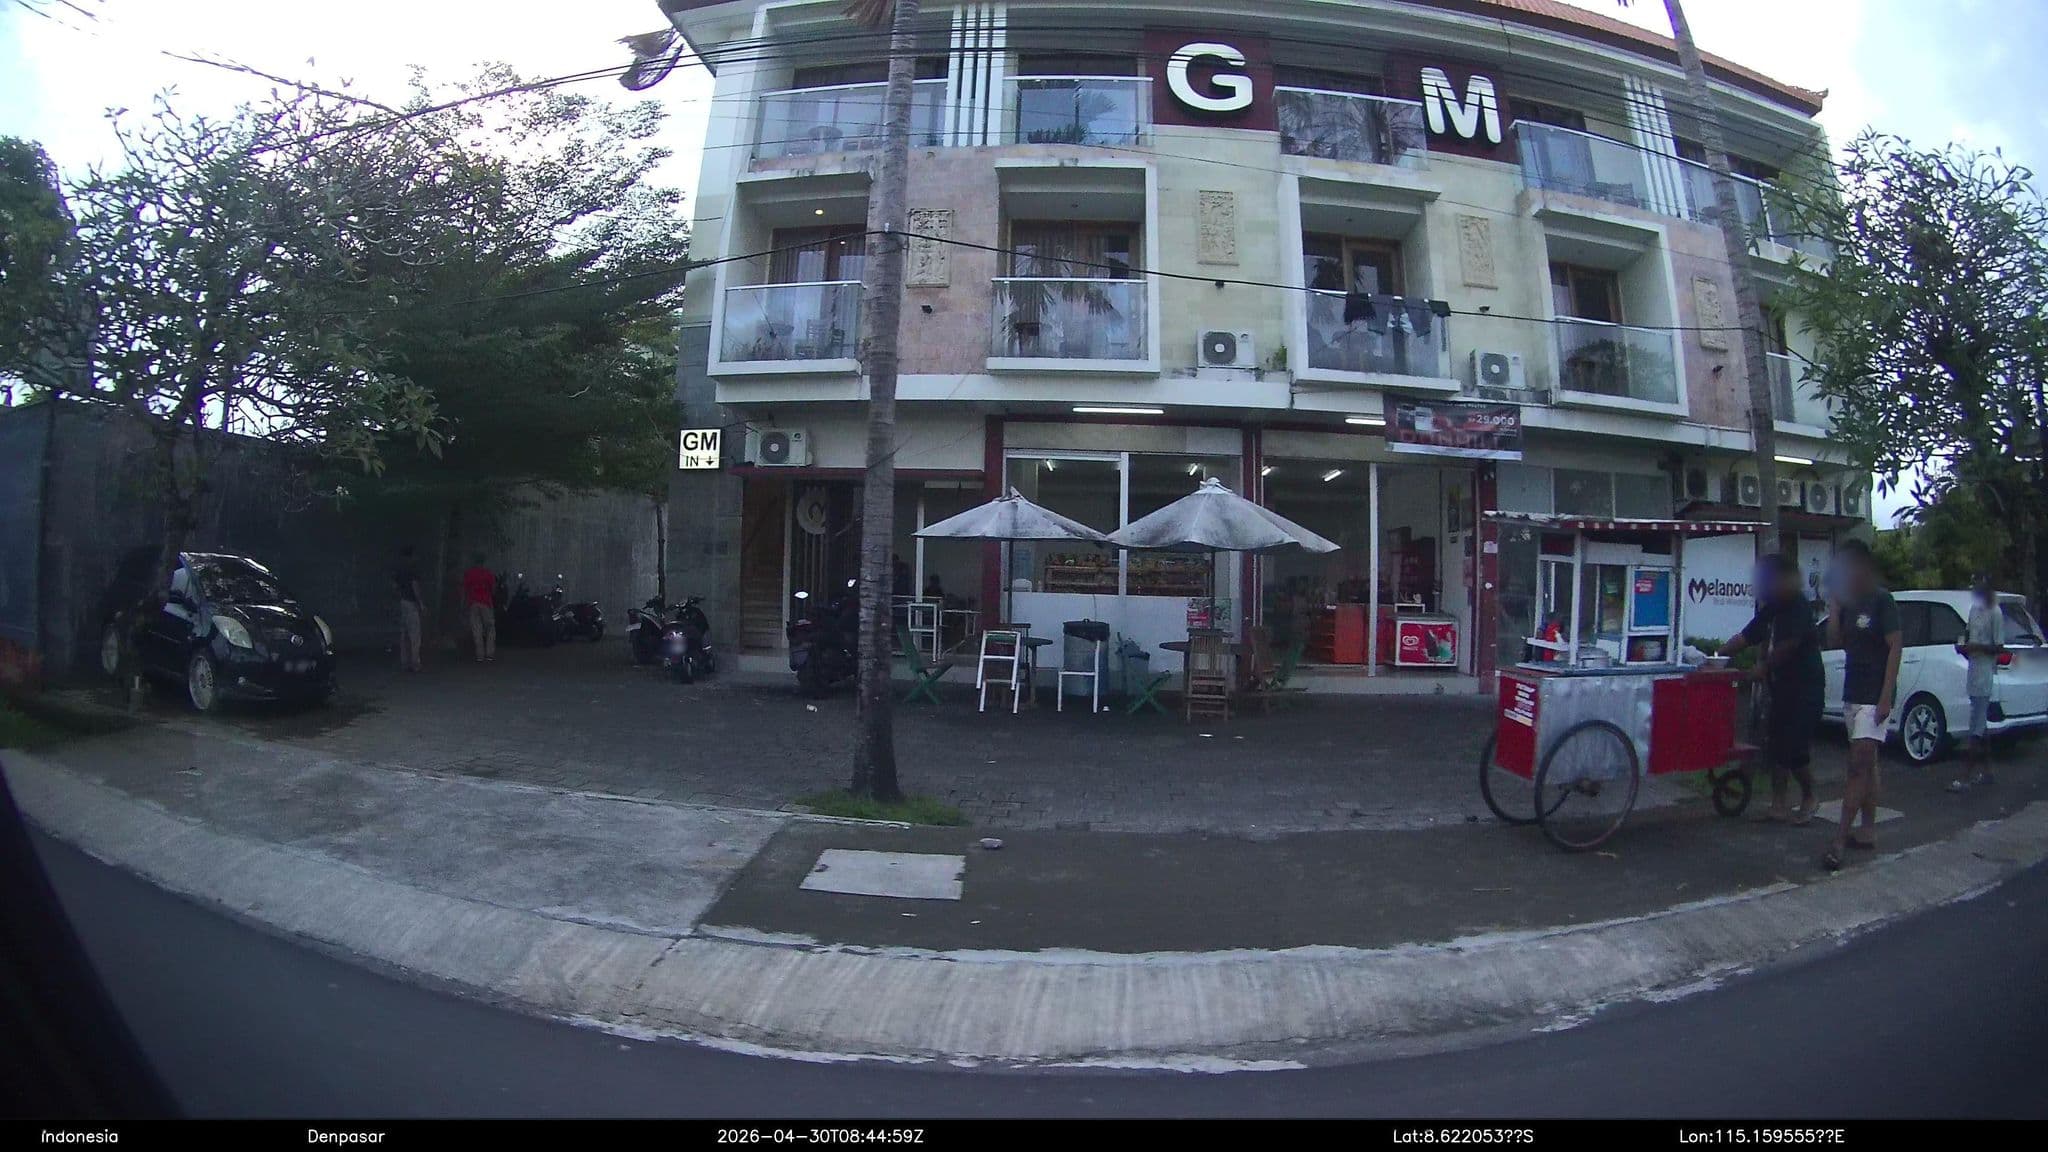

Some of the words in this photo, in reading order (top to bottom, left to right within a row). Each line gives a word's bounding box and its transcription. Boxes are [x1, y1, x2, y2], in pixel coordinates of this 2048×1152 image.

[1166, 42, 1253, 112] G
[1420, 67, 1502, 144] M
[683, 432, 718, 451] GM
[685, 455, 699, 467] IN
